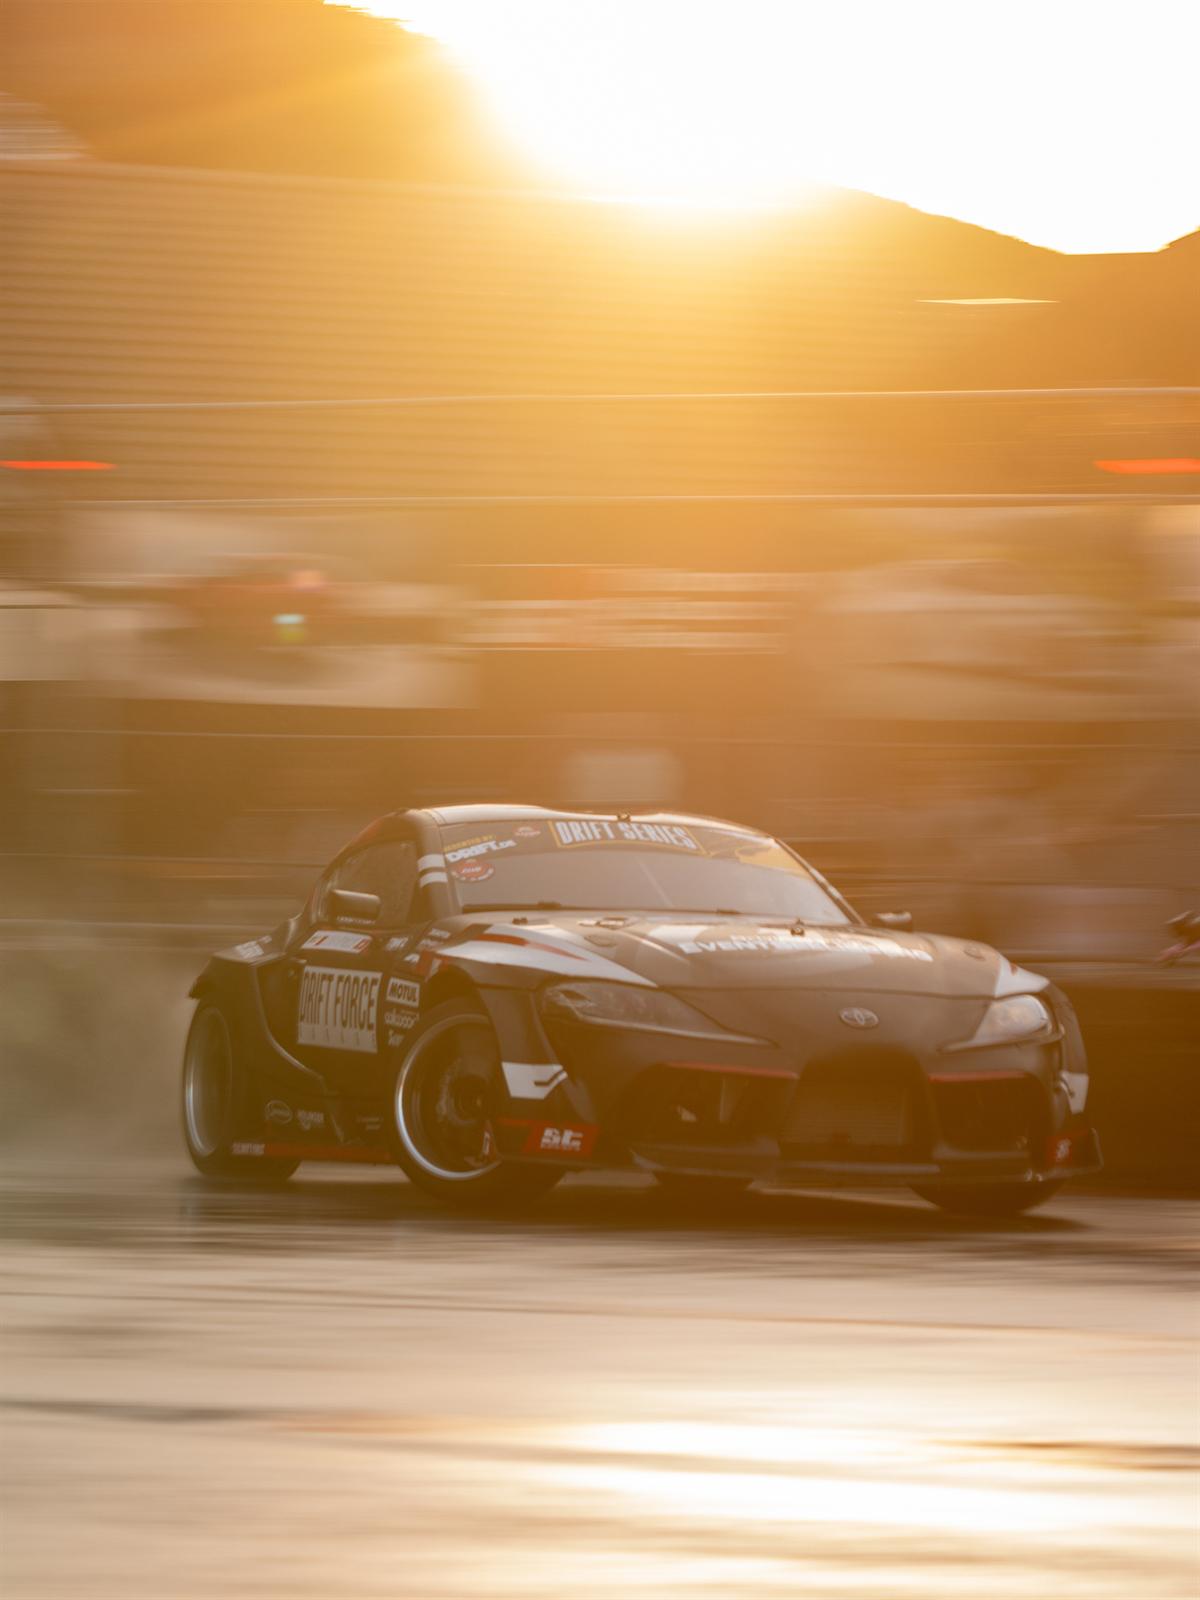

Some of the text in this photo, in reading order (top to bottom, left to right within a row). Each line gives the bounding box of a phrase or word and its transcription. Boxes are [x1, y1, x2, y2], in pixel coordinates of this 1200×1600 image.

[555, 821, 697, 850] DRIFT SERIES
[300, 970, 379, 1031] DRIFT FORCE
[389, 981, 417, 1003] MOTUL
